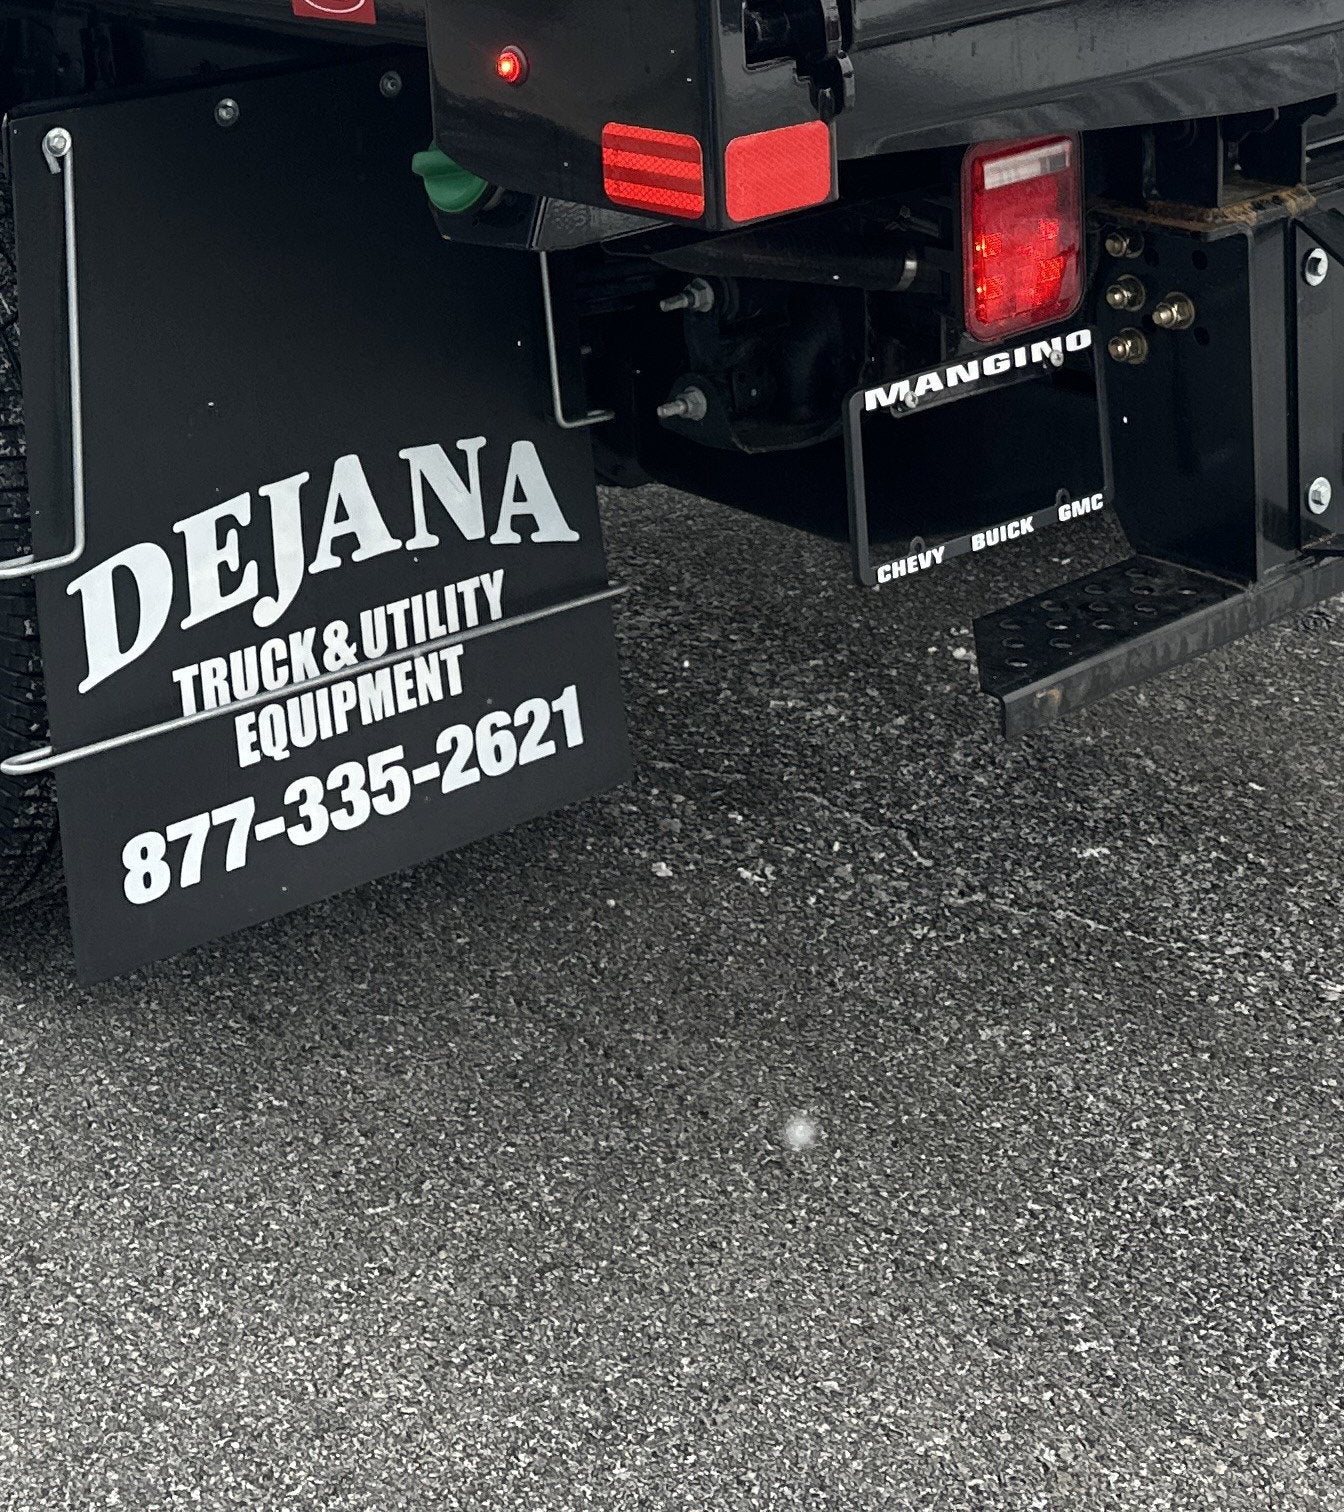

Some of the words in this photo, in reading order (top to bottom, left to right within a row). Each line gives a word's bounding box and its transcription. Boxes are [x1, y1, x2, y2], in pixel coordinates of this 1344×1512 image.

[864, 329, 1092, 411] MANGINO
[66, 435, 580, 694] DEJANA
[877, 546, 945, 583] CHEVY
[972, 516, 1034, 551] BUICK
[1058, 493, 1103, 521] GMC
[234, 644, 464, 768] EQUIPMENT
[121, 684, 584, 905] 877-335-2621
